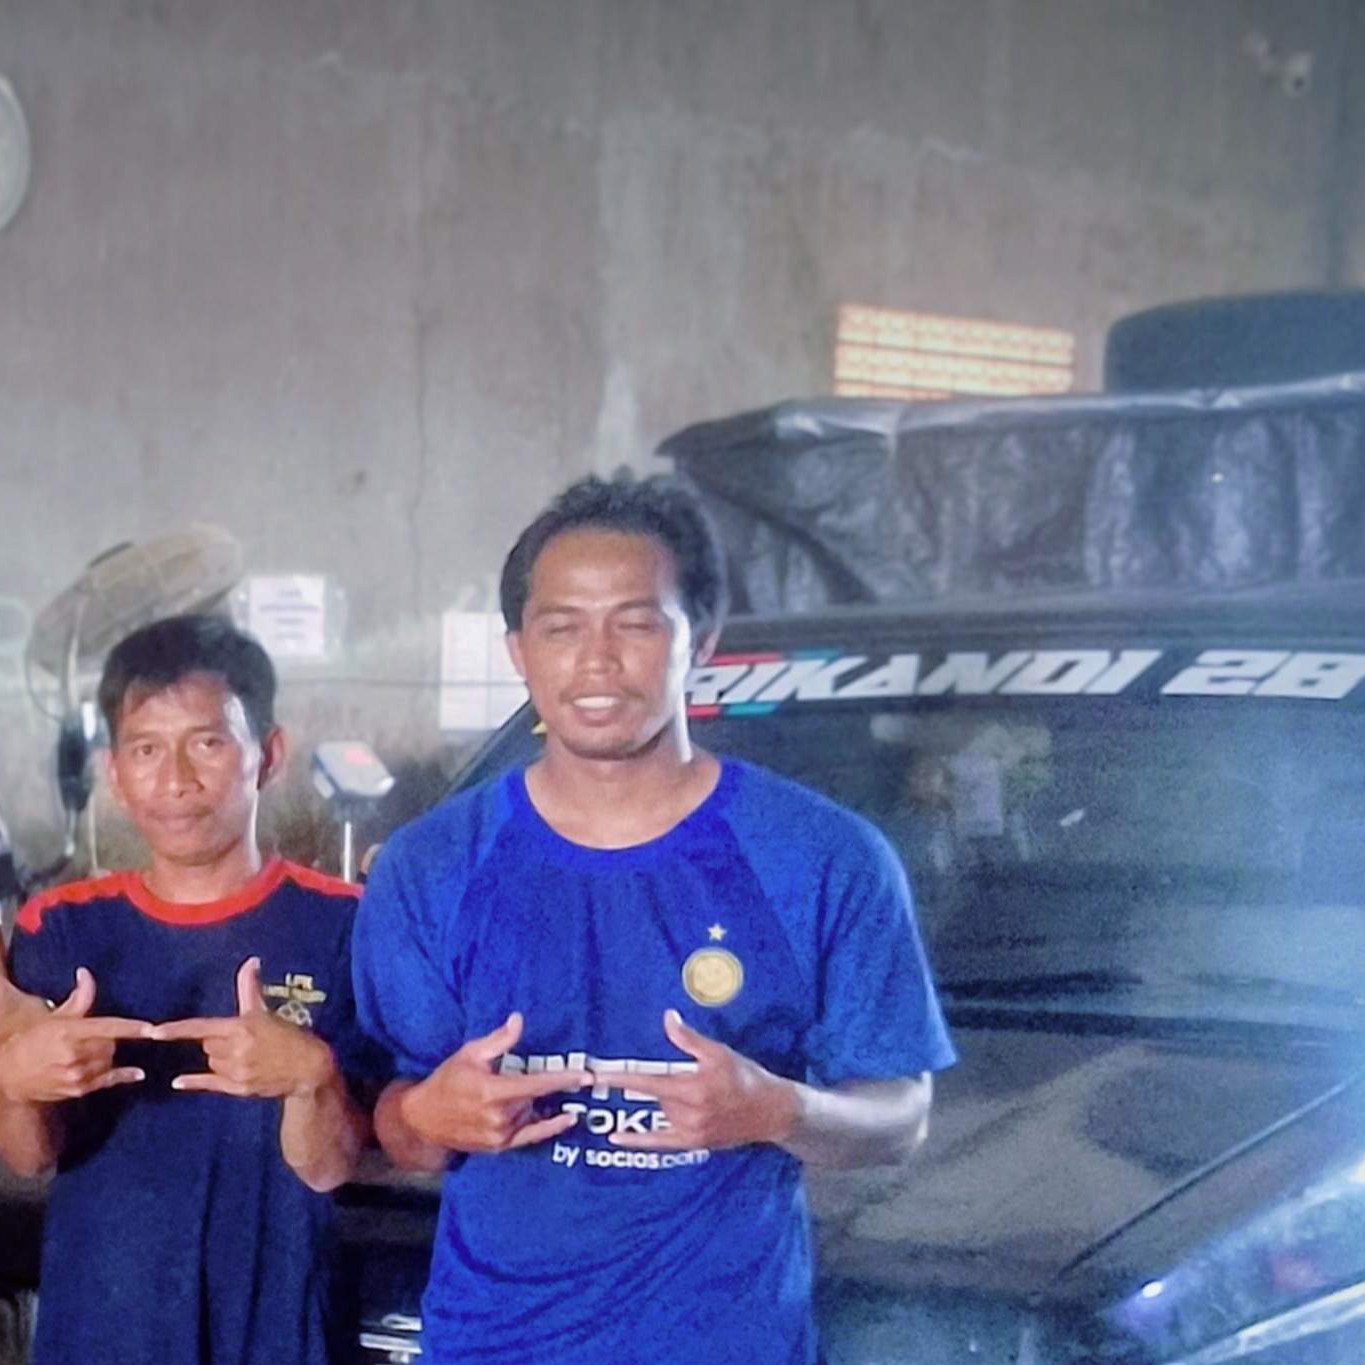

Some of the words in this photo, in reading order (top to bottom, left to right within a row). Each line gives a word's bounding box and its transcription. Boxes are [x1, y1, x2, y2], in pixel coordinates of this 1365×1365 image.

[562, 1102, 673, 1136] TOKE
[552, 1141, 580, 1167] by
[584, 1149, 710, 1170] socios.com
